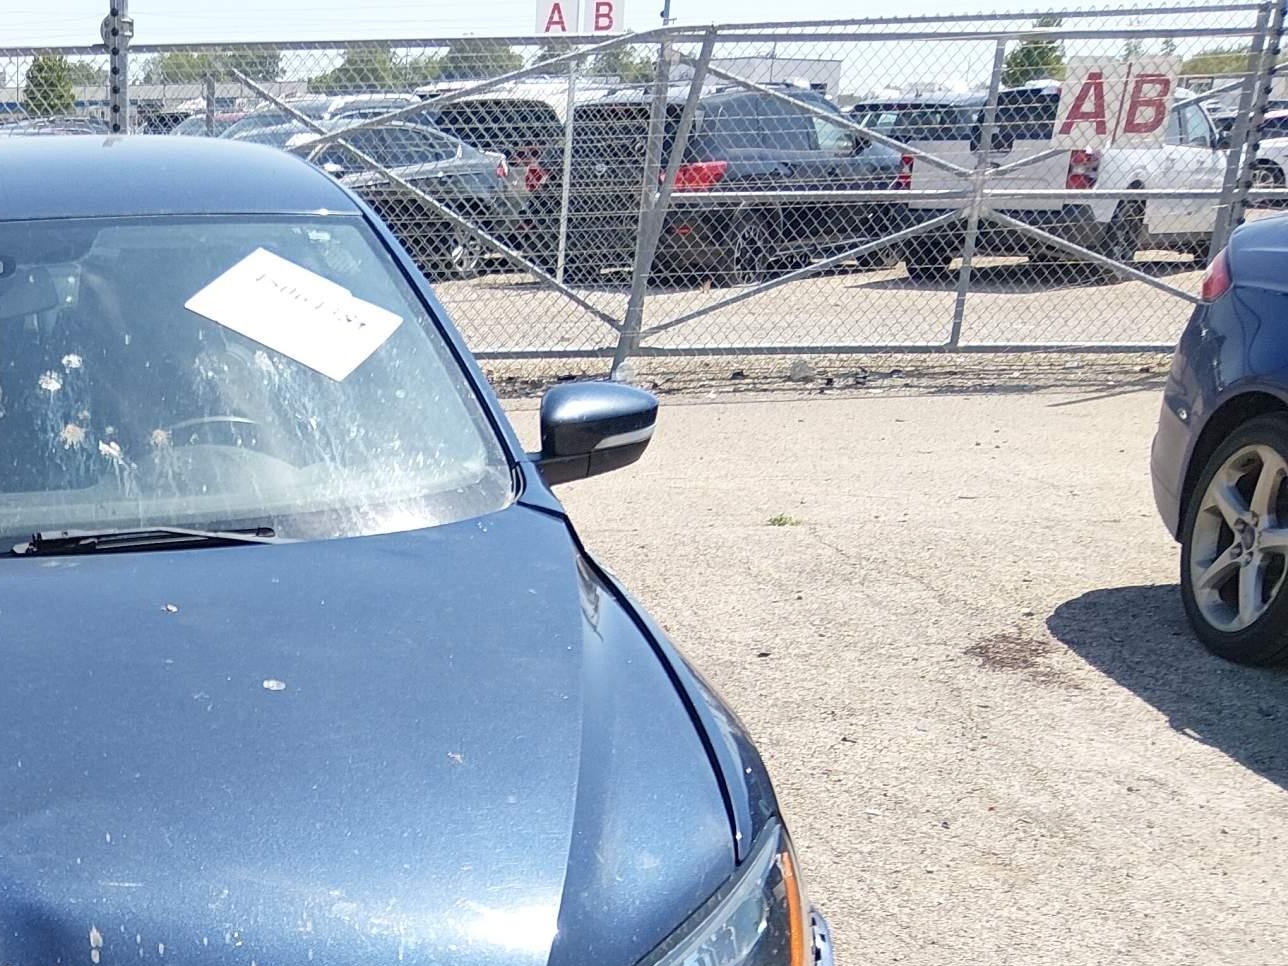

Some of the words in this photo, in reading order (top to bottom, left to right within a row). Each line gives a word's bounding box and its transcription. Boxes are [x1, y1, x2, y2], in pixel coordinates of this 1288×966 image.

[545, 2, 567, 33] A
[594, 1, 614, 31] B
[1059, 71, 1107, 135] A
[1123, 73, 1171, 134] B
